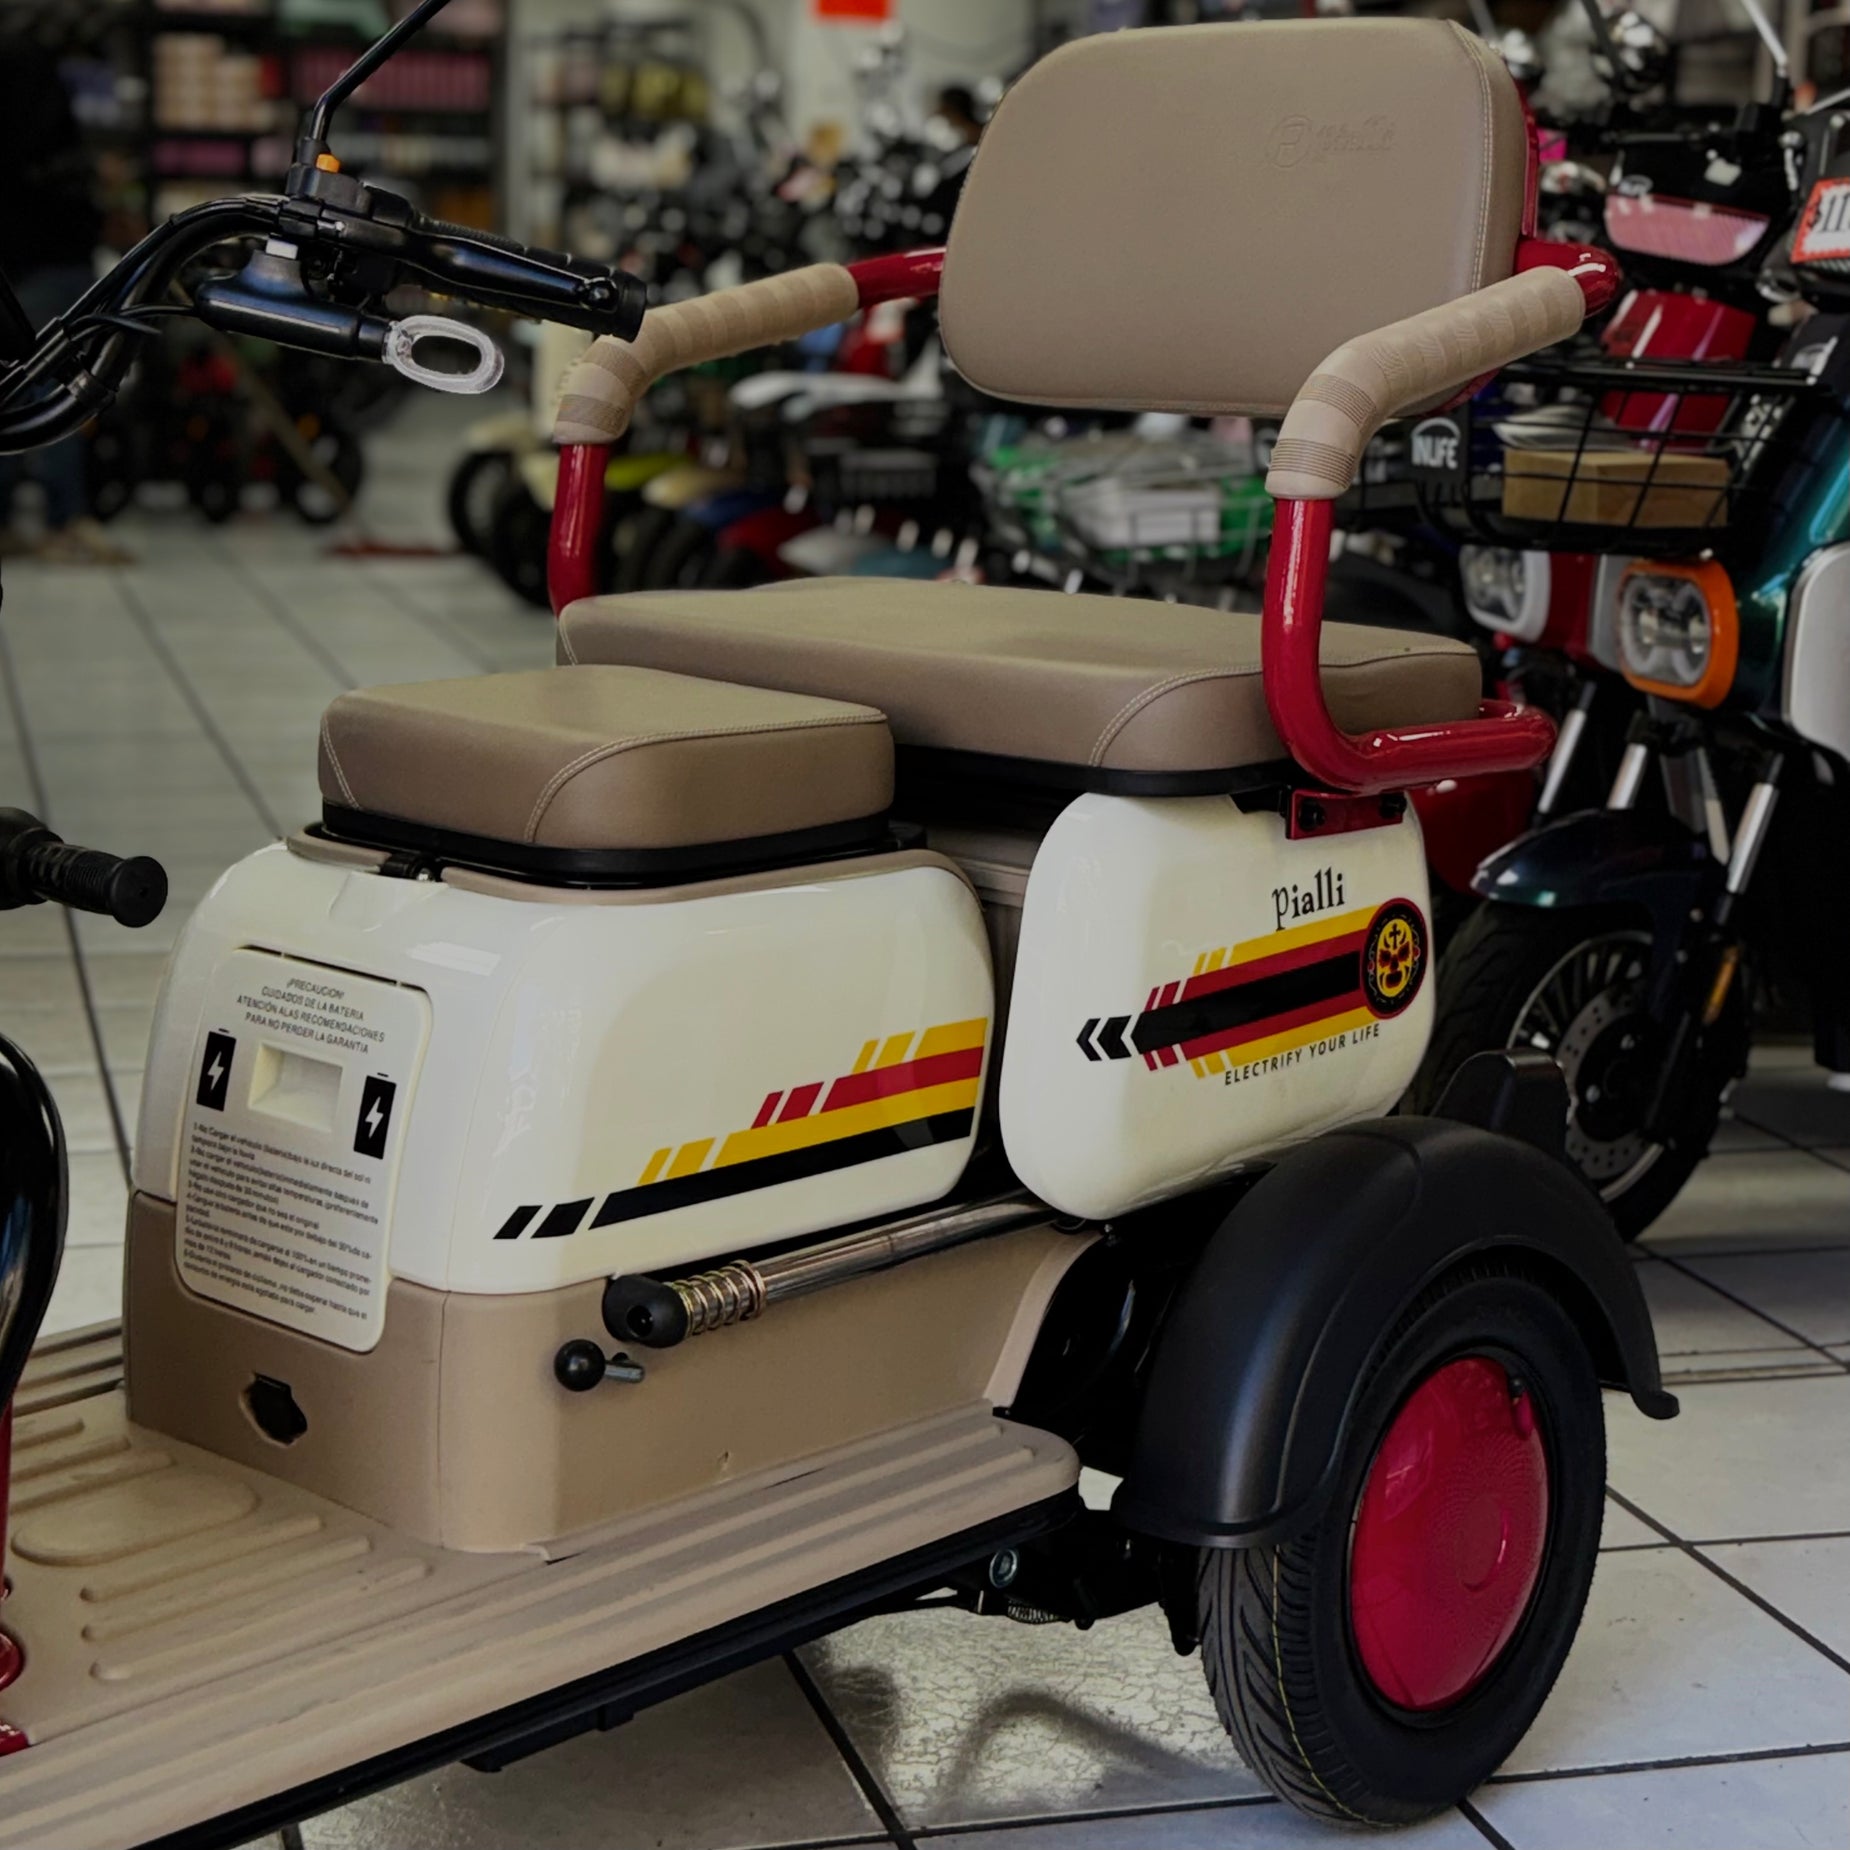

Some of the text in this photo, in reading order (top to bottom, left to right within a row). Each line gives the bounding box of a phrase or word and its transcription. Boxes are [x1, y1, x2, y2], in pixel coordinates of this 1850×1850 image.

[304, 998, 316, 1009] DE
[317, 1001, 328, 1012] LA
[245, 1011, 268, 1025] PARA
[268, 1018, 281, 1030] NO
[315, 1031, 326, 1042] LA
[1225, 1023, 1380, 1086] ELECTRIFY YOUR LIFE
